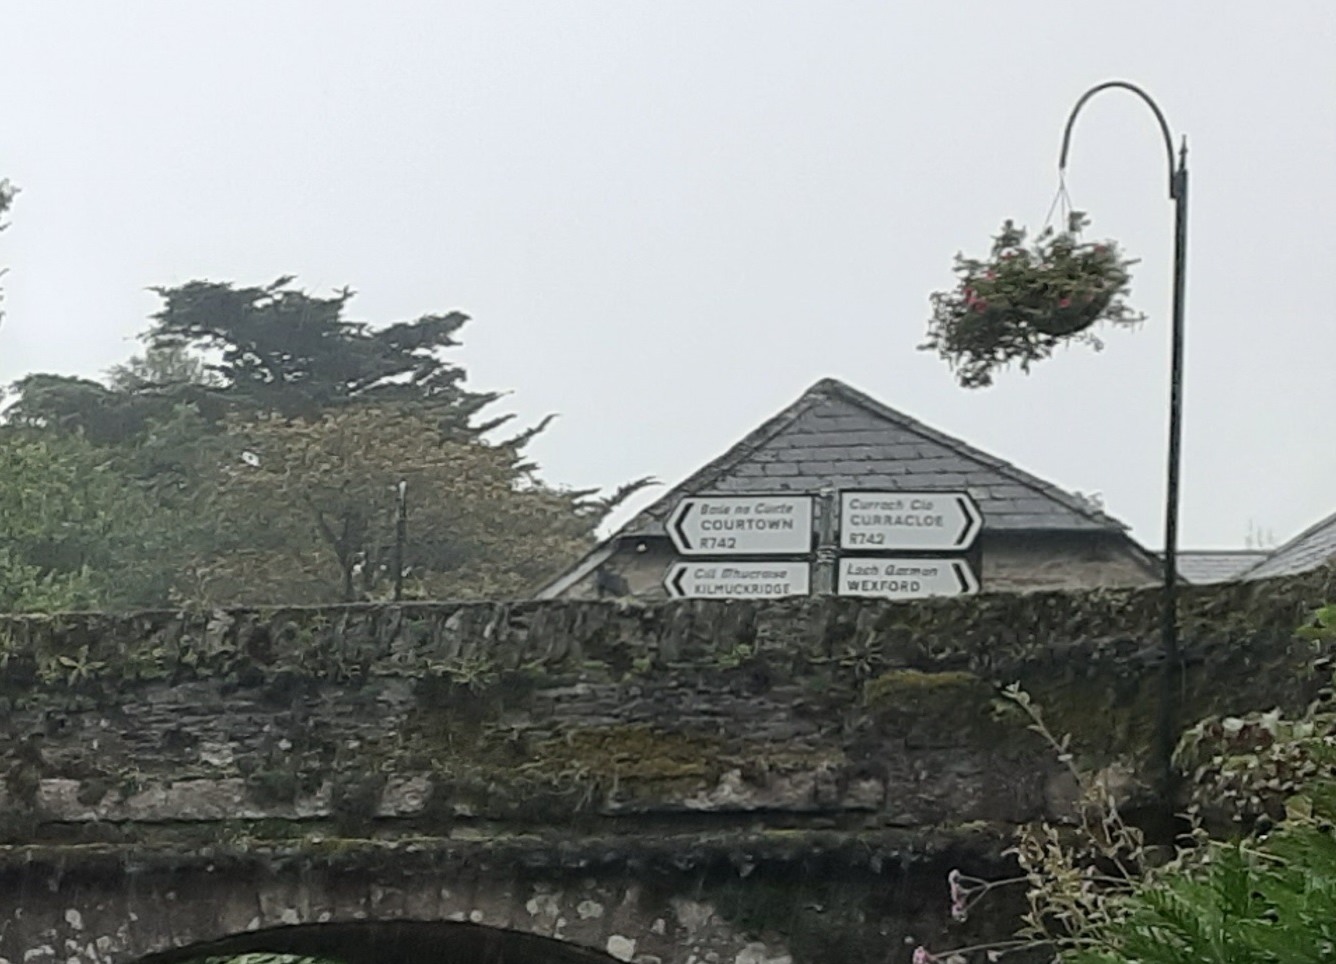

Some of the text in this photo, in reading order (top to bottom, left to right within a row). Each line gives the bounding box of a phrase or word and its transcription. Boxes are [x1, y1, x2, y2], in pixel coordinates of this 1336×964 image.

[700, 518, 794, 531] COURTOWN
[849, 514, 944, 527] CURRACLOE
[700, 537, 737, 549] R742
[849, 532, 886, 545] R742
[847, 562, 879, 576] Loch
[694, 583, 791, 595] KILMUCKRIDGE
[847, 580, 921, 592] WEXFORD
